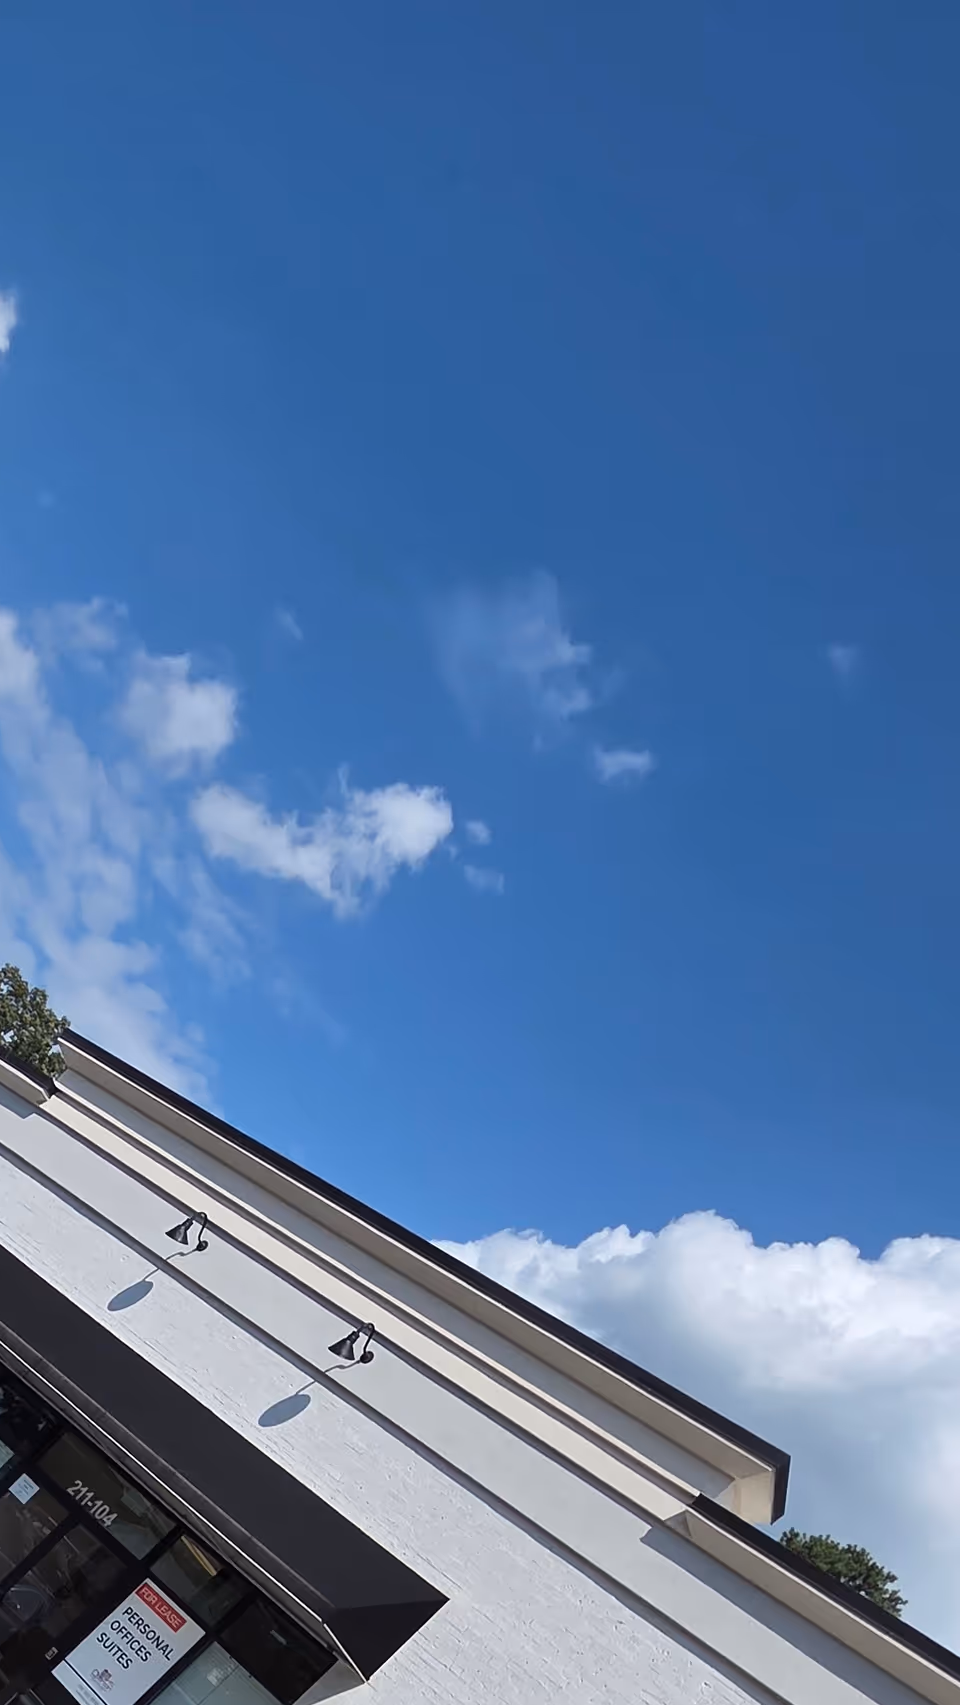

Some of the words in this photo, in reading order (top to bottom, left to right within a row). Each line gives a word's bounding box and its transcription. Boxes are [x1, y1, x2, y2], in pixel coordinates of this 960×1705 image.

[66, 1480, 118, 1527] 211-104
[139, 1588, 158, 1605] FOR
[155, 1601, 182, 1629] LEASE
[96, 1632, 133, 1670] SUITES
[110, 1620, 152, 1663] OFFICES
[122, 1606, 175, 1661] PERSONAL
